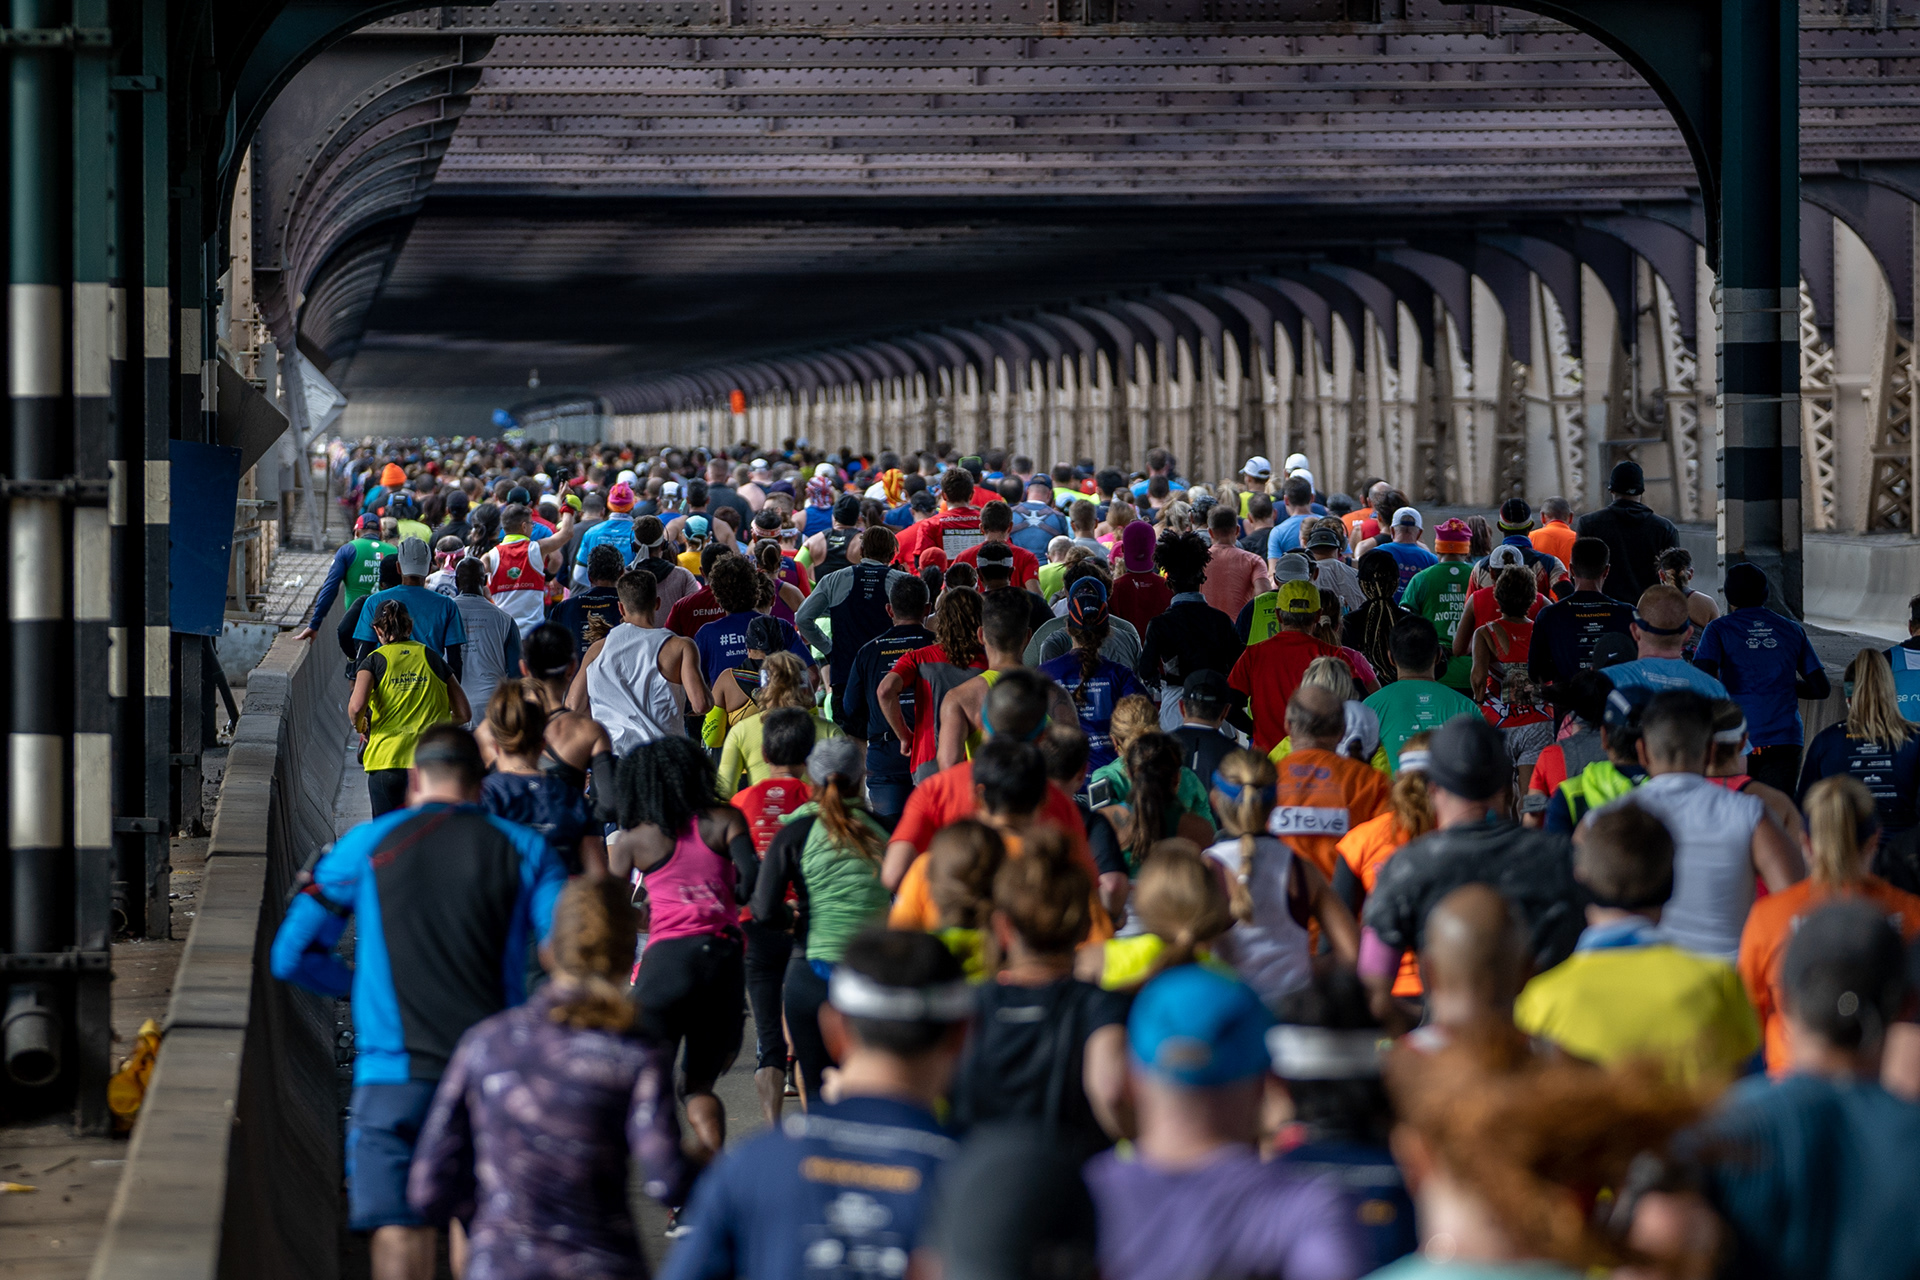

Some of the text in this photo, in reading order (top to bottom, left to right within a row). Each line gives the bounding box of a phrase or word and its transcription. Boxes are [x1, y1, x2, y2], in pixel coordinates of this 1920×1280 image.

[1439, 593, 1467, 603] RUNNIN
[1449, 602, 1465, 611] FOR
[719, 633, 746, 646] #En
[1280, 807, 1344, 831] Steve
